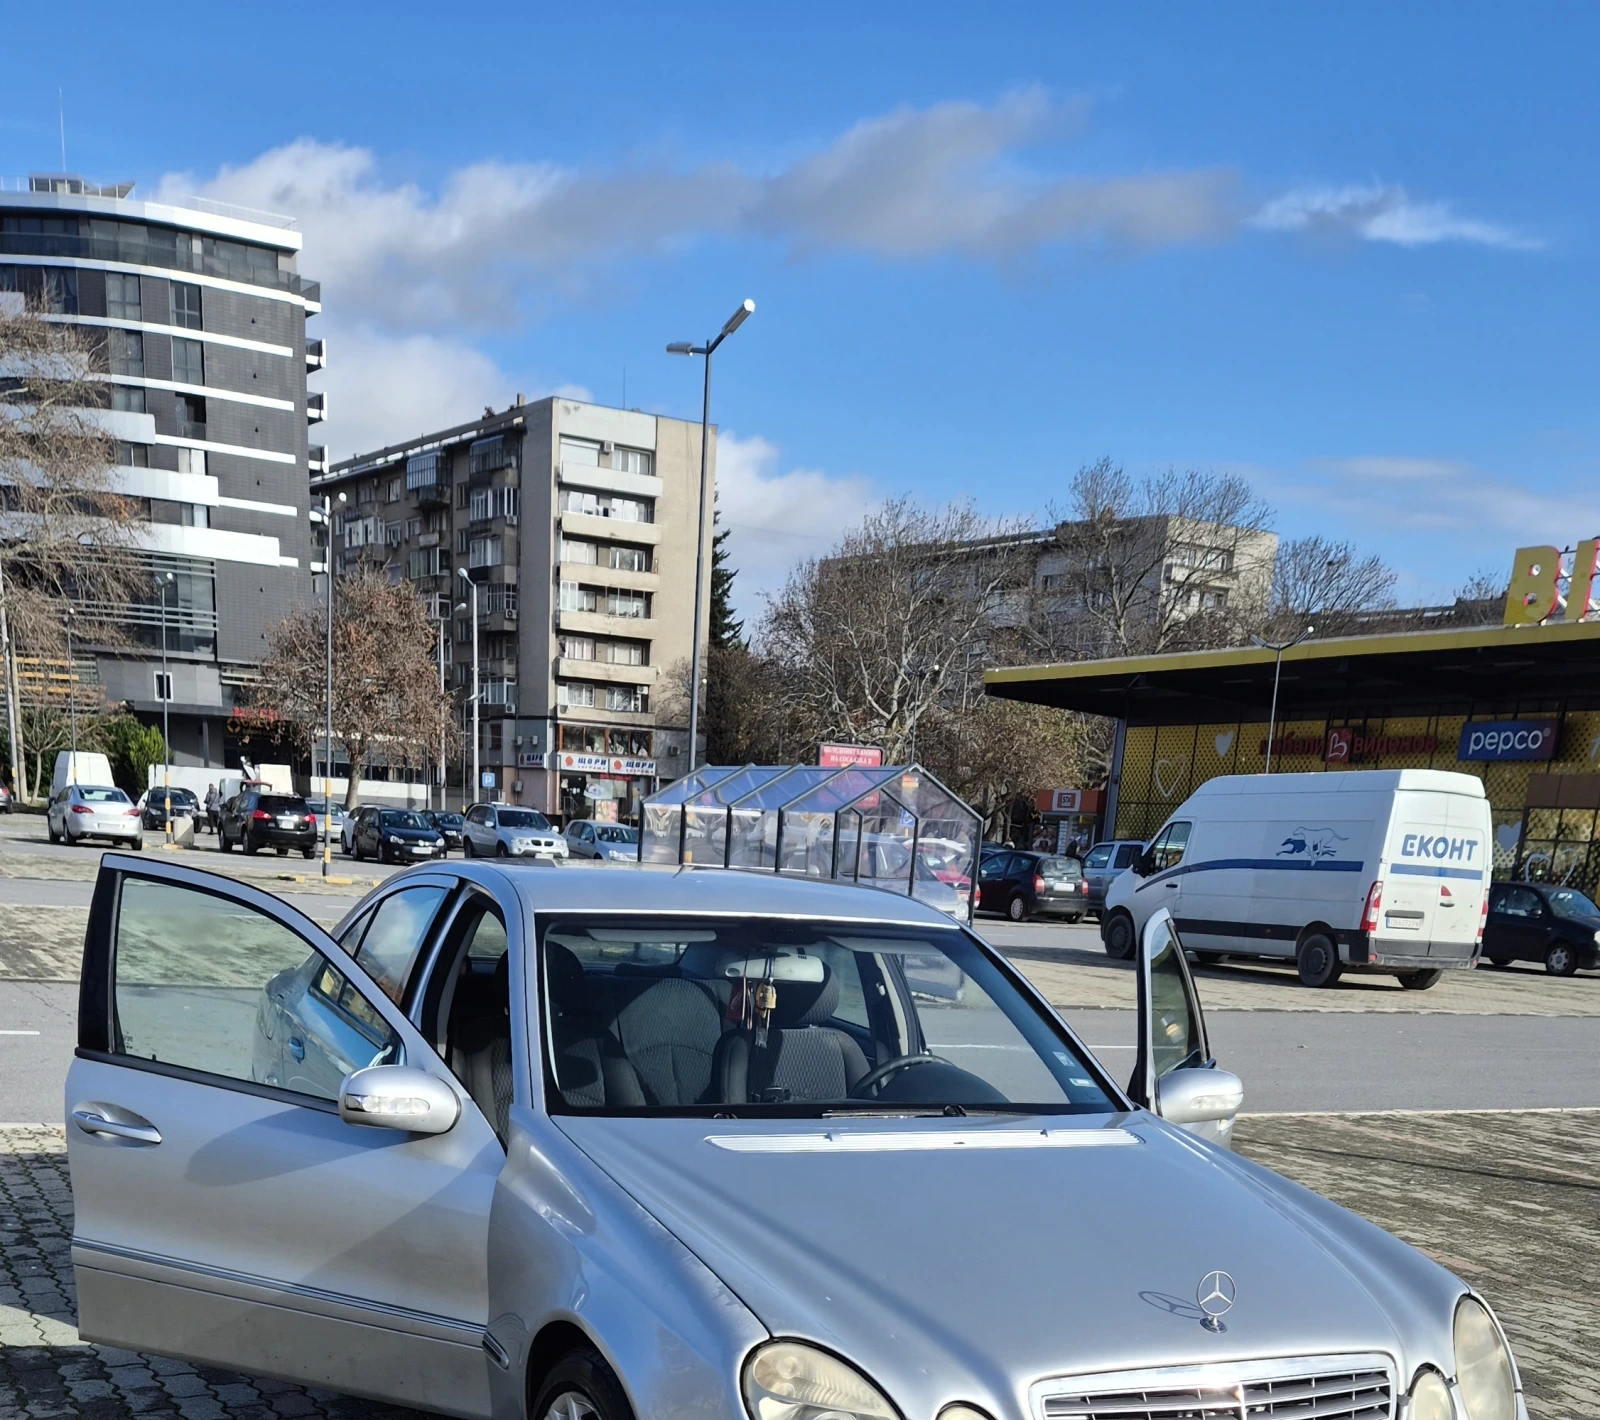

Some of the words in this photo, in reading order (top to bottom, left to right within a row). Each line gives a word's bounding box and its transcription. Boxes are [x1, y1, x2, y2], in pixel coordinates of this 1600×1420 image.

[1468, 730, 1543, 755] pepco
[577, 756, 607, 766] ЩОРИ
[625, 761, 655, 770] ЩОРИ
[1401, 834, 1478, 861] ЕКОНТ
